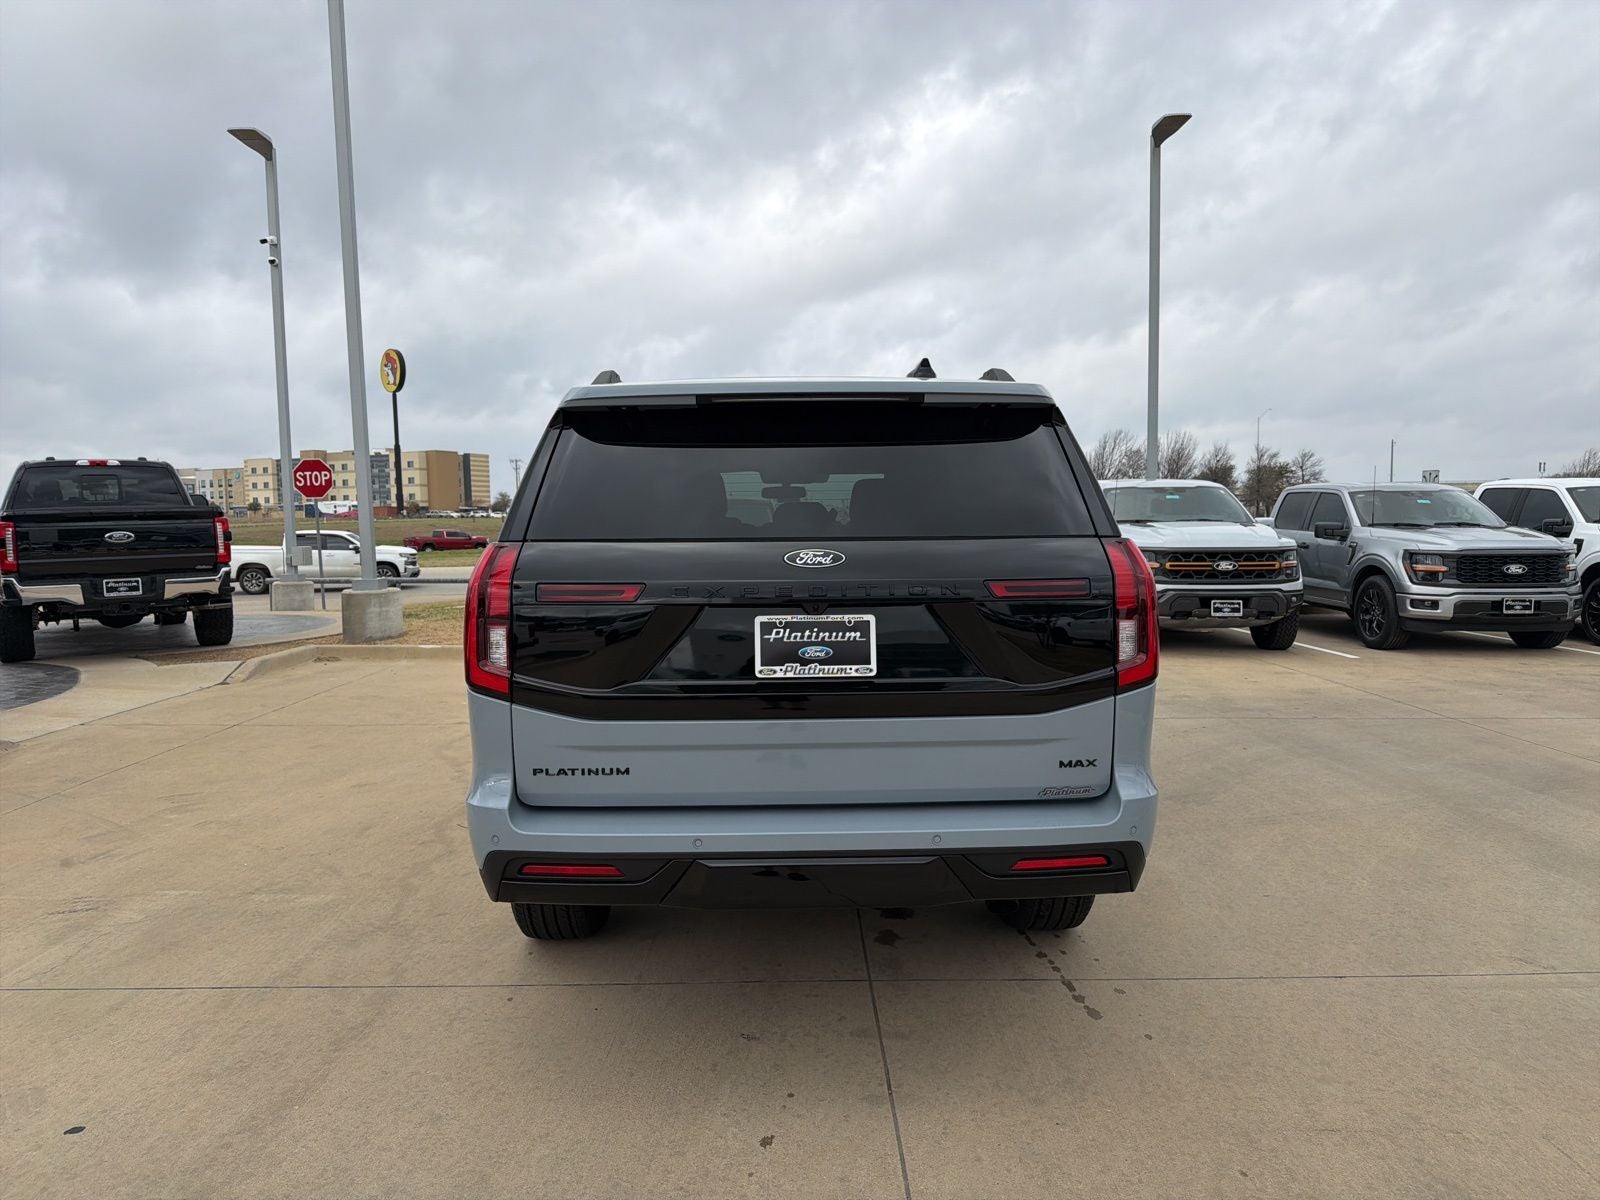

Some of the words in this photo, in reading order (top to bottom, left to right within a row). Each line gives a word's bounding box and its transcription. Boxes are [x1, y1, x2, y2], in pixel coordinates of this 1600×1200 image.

[296, 471, 330, 486] STOP
[796, 551, 833, 564] Ford
[671, 584, 961, 598] EXPEDITION
[763, 627, 867, 642] Platinum
[804, 648, 826, 657] Ford
[782, 663, 852, 675] Platinum
[1058, 759, 1098, 768] MAX
[532, 768, 630, 776] PLATINUM
[1038, 786, 1095, 797] Platinum
